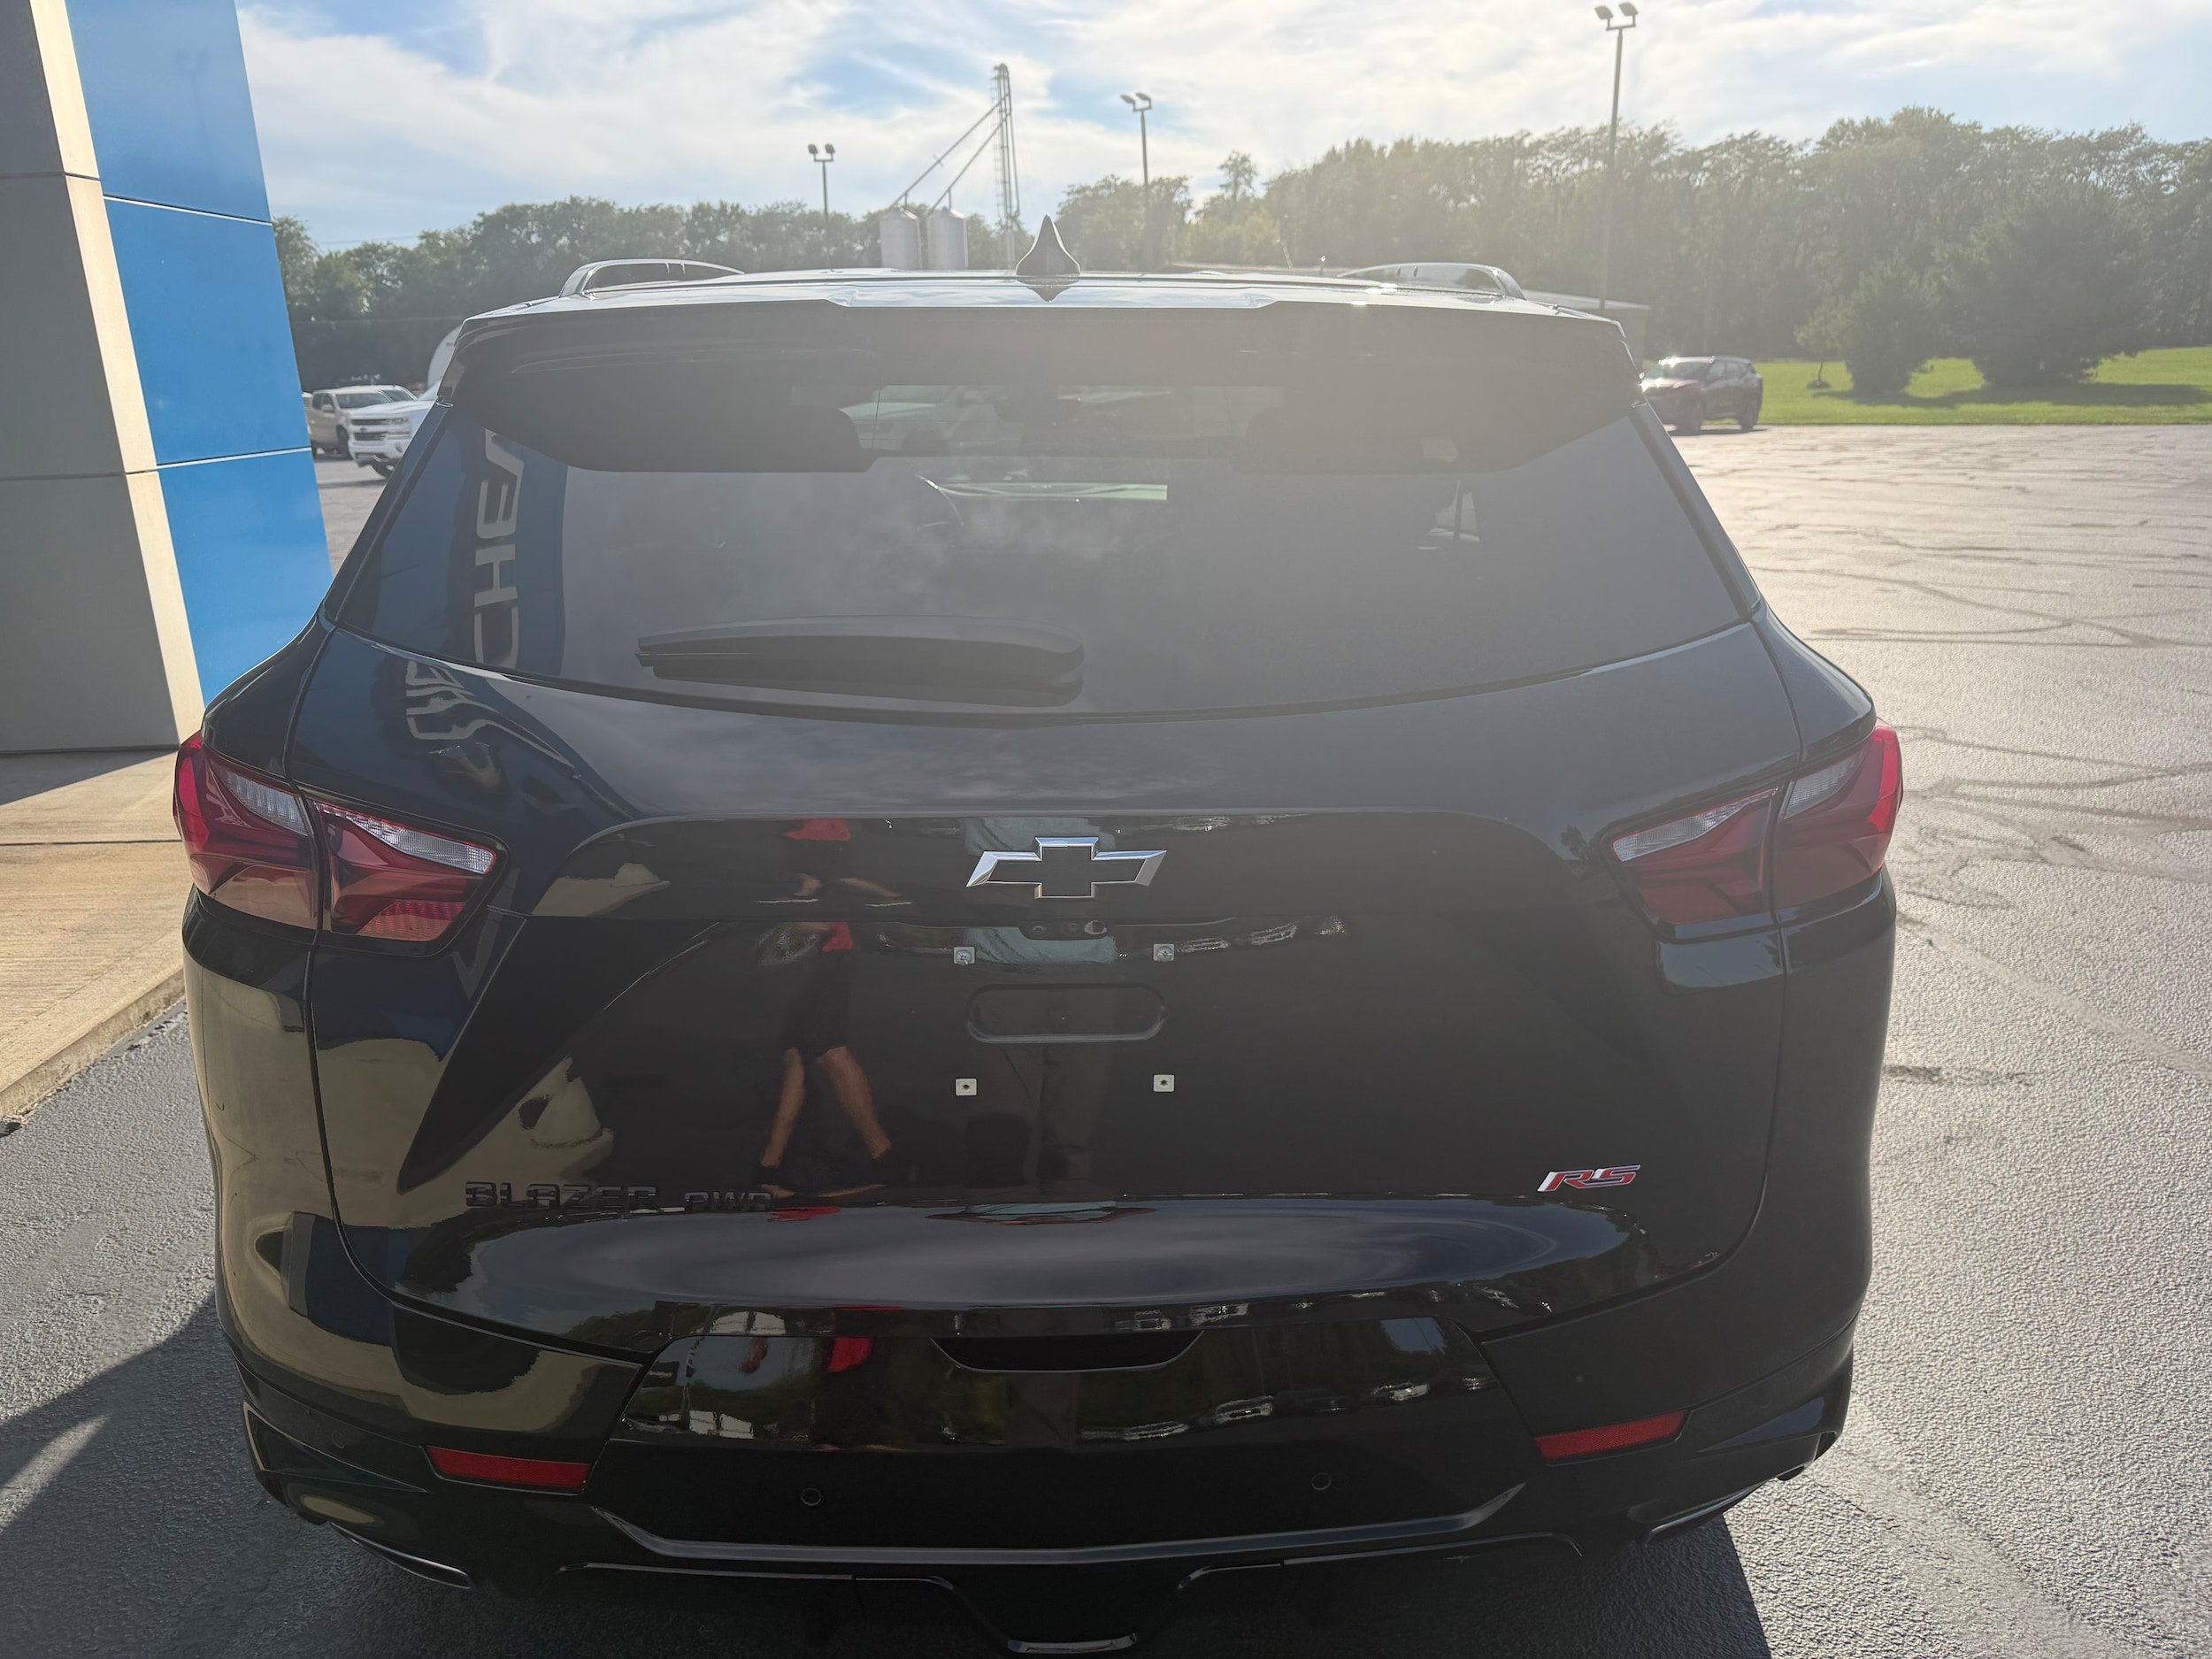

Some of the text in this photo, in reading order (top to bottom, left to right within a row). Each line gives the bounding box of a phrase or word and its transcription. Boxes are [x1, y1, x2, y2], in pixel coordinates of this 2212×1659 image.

[1537, 1164, 1641, 1193] RS
[465, 1181, 772, 1213] BLAZER AWD
